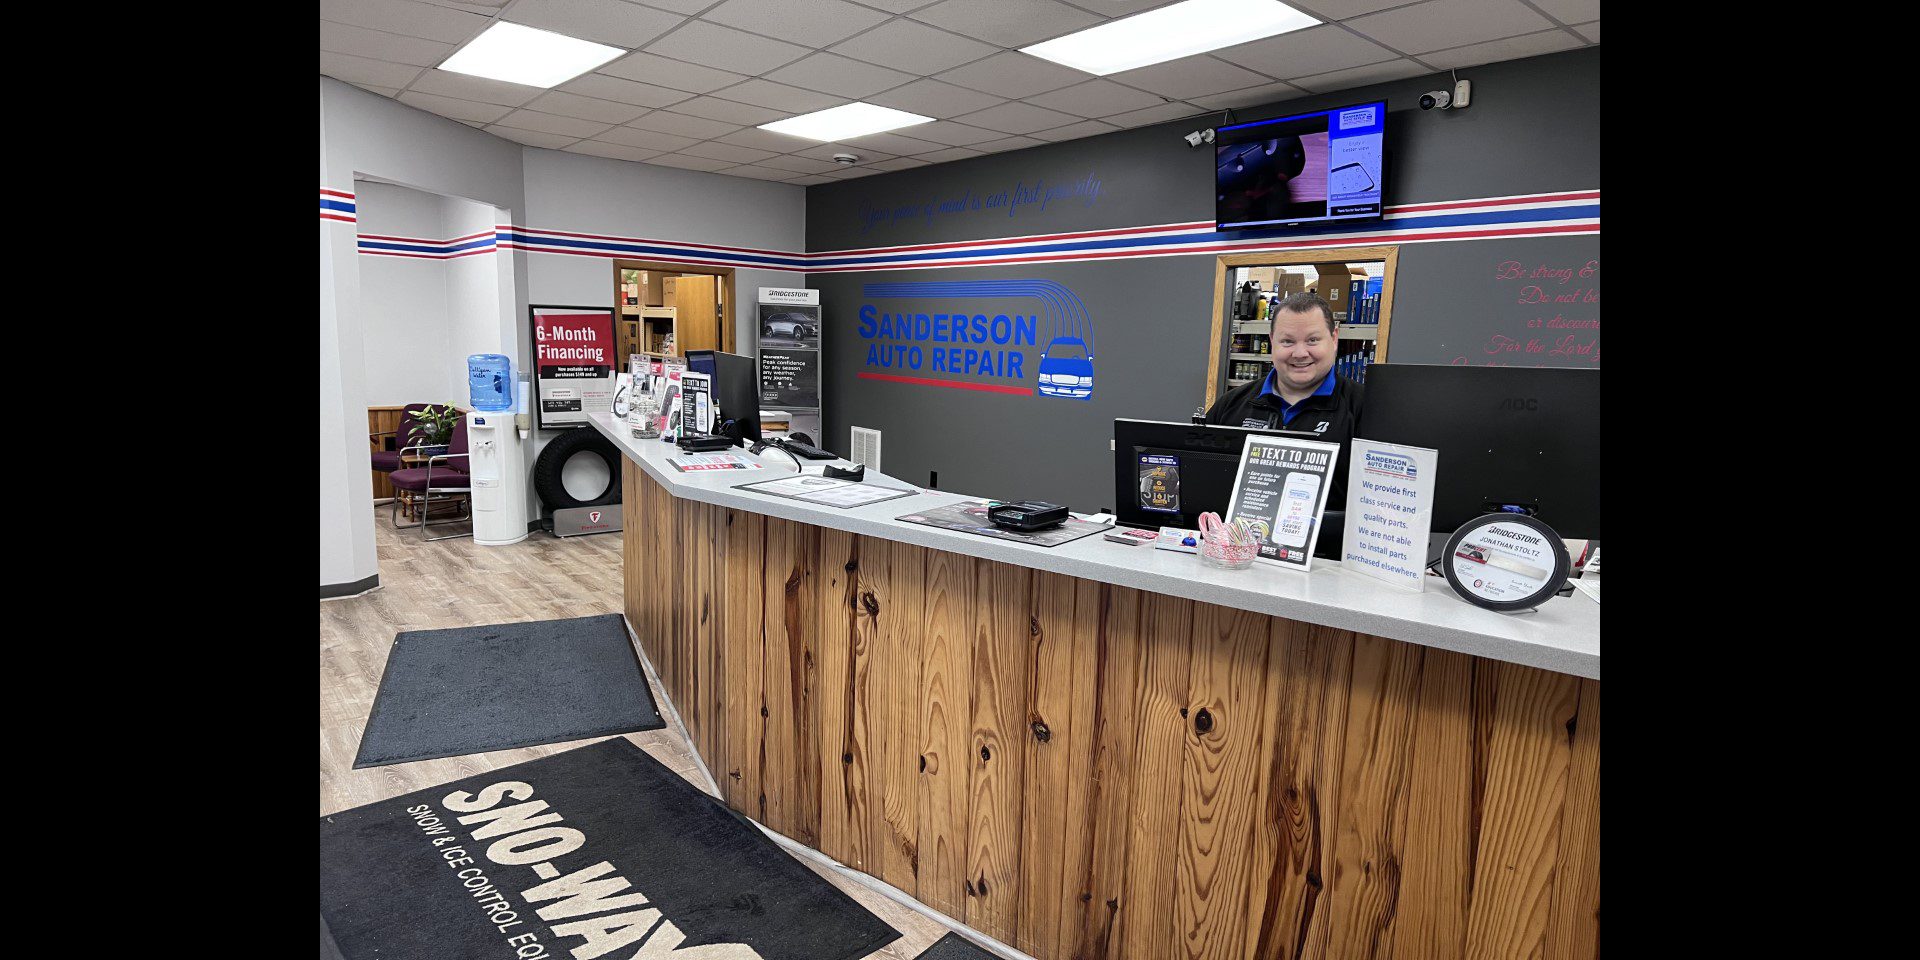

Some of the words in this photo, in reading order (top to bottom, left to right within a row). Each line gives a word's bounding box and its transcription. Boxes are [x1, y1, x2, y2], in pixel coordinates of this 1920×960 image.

[971, 198, 982, 210] is
[986, 191, 1008, 209] our
[1008, 180, 1042, 217] first
[1496, 260, 1526, 280] Be
[1530, 265, 1573, 285] strong
[768, 289, 809, 298] BRIDGESTONE
[1518, 286, 1550, 304] Do
[1556, 289, 1581, 303] not
[537, 325, 596, 341] 6-Month
[858, 304, 1037, 346] SANDERSON
[538, 344, 604, 362] Financing
[1549, 334, 1596, 357] Lord
[866, 343, 924, 370] AUTO
[933, 347, 1024, 379] REPAIR
[1260, 459, 1276, 467] GREAT
[1276, 460, 1300, 469] REWARDS
[1300, 463, 1325, 472] PROGRAM
[1261, 447, 1287, 461] TEXT
[1289, 450, 1303, 463] TO
[1303, 451, 1329, 466] JOIN
[1365, 453, 1407, 467] SANDERSON
[1367, 461, 1382, 470] AUTO
[1383, 463, 1405, 473] REPAIR
[1362, 481, 1373, 489] We
[1374, 482, 1401, 495] provide
[1402, 487, 1416, 498] first
[1359, 496, 1375, 506] class
[1377, 499, 1401, 511] service
[1402, 505, 1416, 514] and
[1363, 512, 1387, 525] quality
[1388, 519, 1408, 529] parts.
[1358, 526, 1369, 535] We
[1370, 530, 1382, 539] are
[1382, 532, 1395, 542] not
[1396, 536, 1412, 547] able
[1488, 525, 1542, 546] BRIDGESTONE
[1359, 541, 1367, 549] to
[1367, 543, 1388, 555] install
[1390, 550, 1407, 561] parts
[1480, 536, 1514, 550] JONATHAN
[1514, 545, 1541, 557] STOLTZ
[1346, 552, 1380, 568] purchased
[1381, 562, 1419, 580] elsewhere.
[406, 804, 450, 835] SNOW
[432, 836, 456, 846] &
[440, 845, 474, 869] ICE
[442, 781, 766, 960] SNO-WAY
[457, 868, 523, 934] CONTROL
